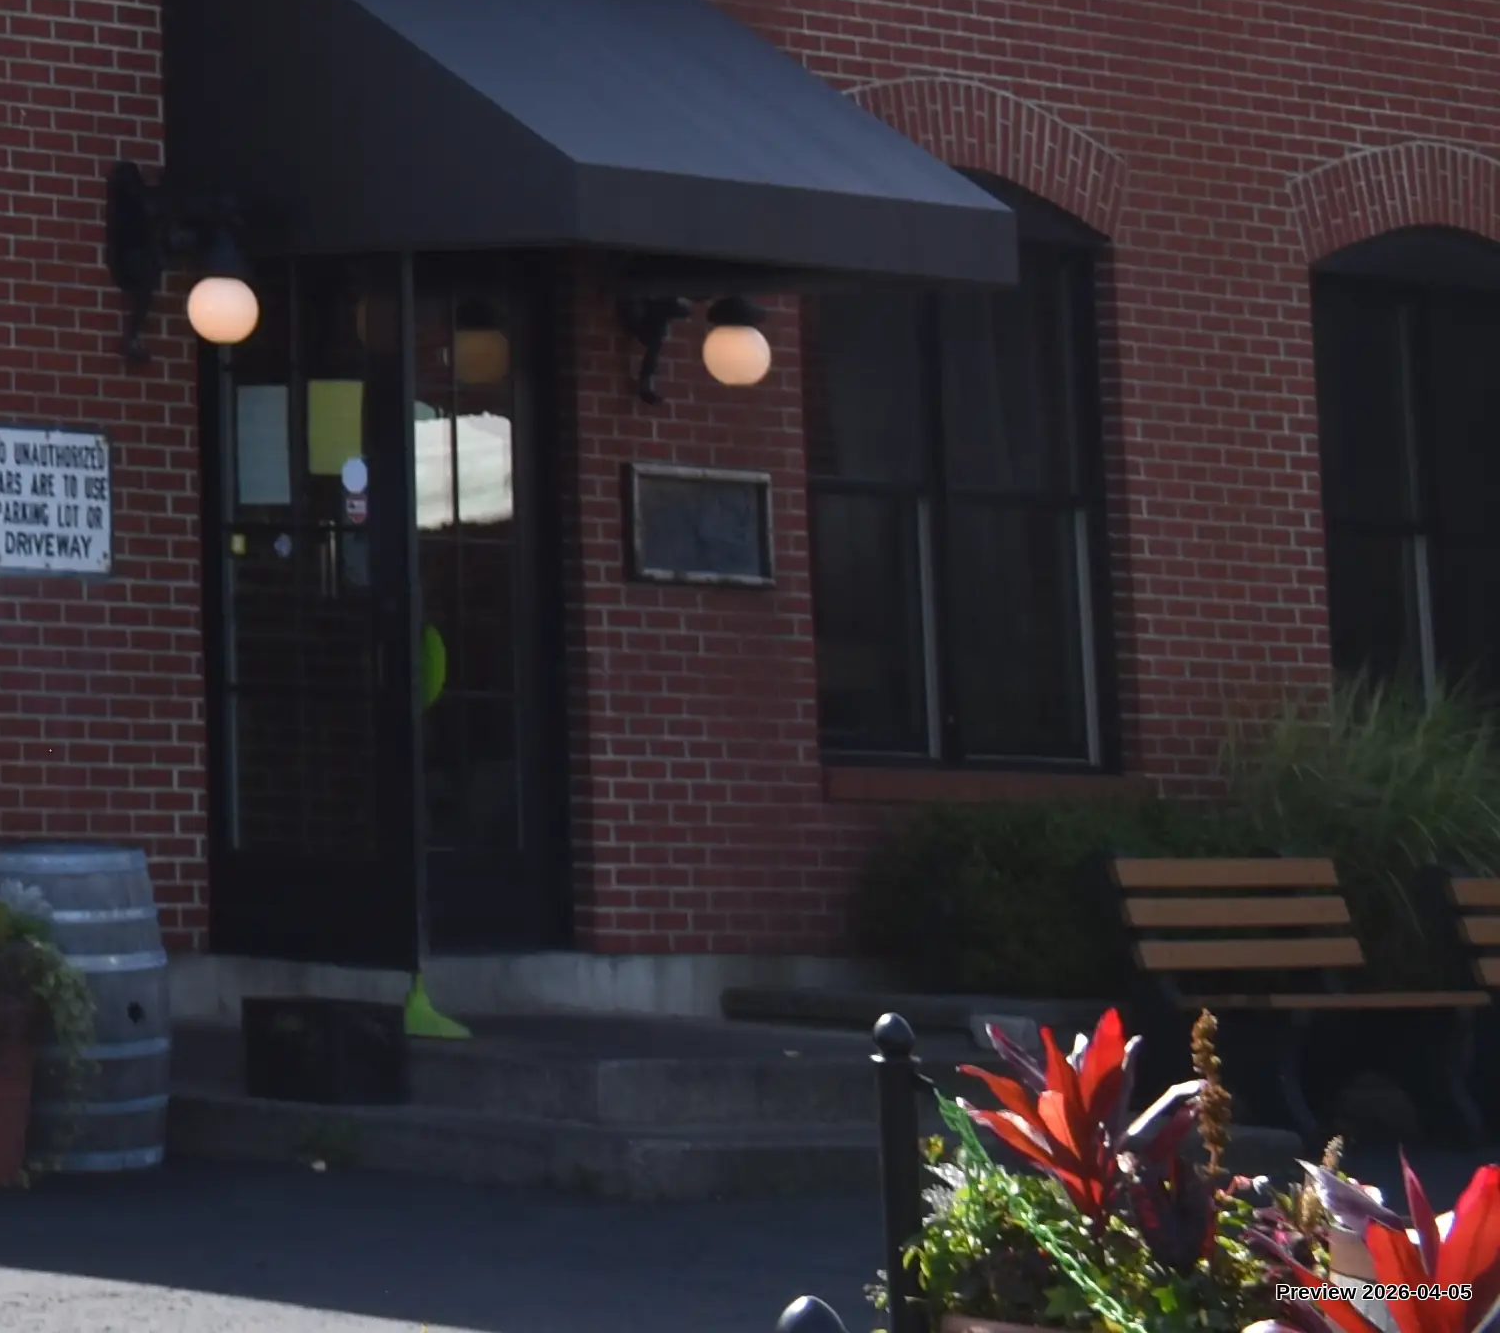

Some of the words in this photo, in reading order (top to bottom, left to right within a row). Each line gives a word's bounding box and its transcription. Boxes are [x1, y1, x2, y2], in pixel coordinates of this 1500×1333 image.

[14, 442, 106, 470] UNAUTHORIZED
[31, 473, 54, 497] ARE
[63, 474, 77, 499] TO
[84, 477, 107, 501] USE
[57, 504, 79, 528] LOT
[86, 505, 103, 530] OR
[4, 531, 92, 559] DRIVEWAY
